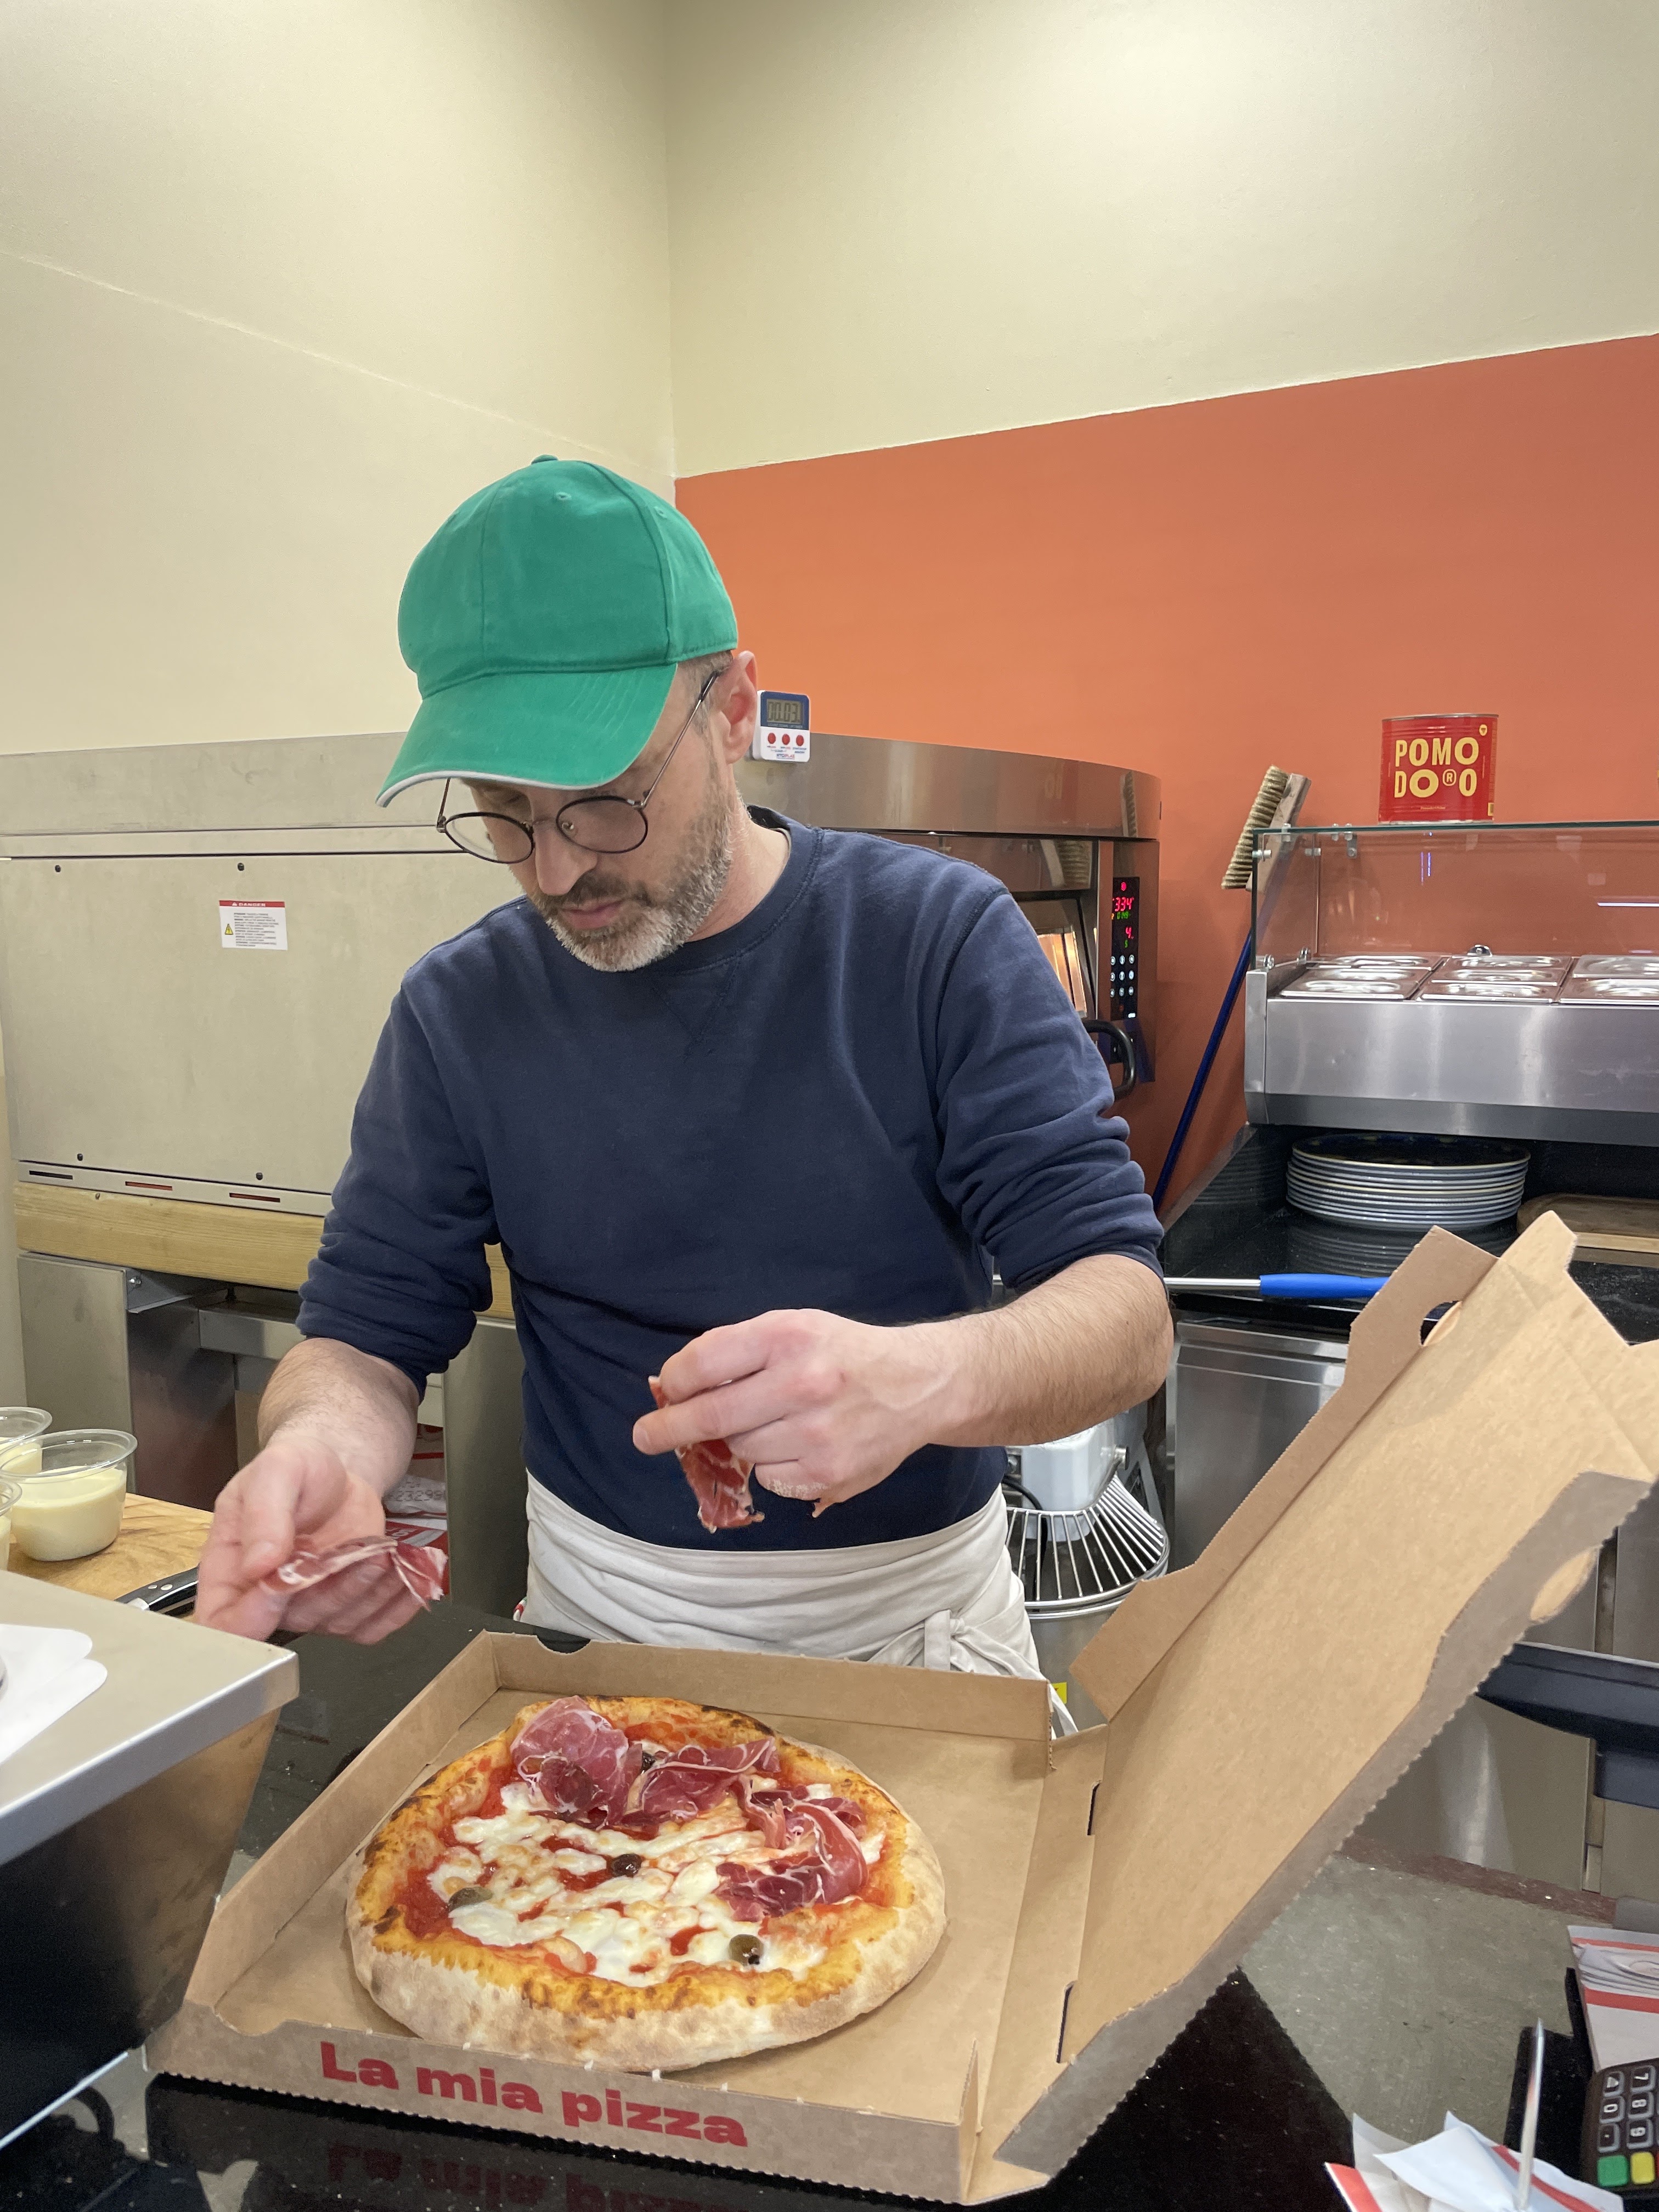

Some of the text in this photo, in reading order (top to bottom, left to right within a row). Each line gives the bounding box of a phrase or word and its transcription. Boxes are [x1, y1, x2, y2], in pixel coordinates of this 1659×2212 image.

[1395, 737, 1479, 767] POMO
[321, 2041, 747, 2147] La mia pizza
[1632, 2099, 1646, 2108] 8
[1604, 2103, 1618, 2112] 0
